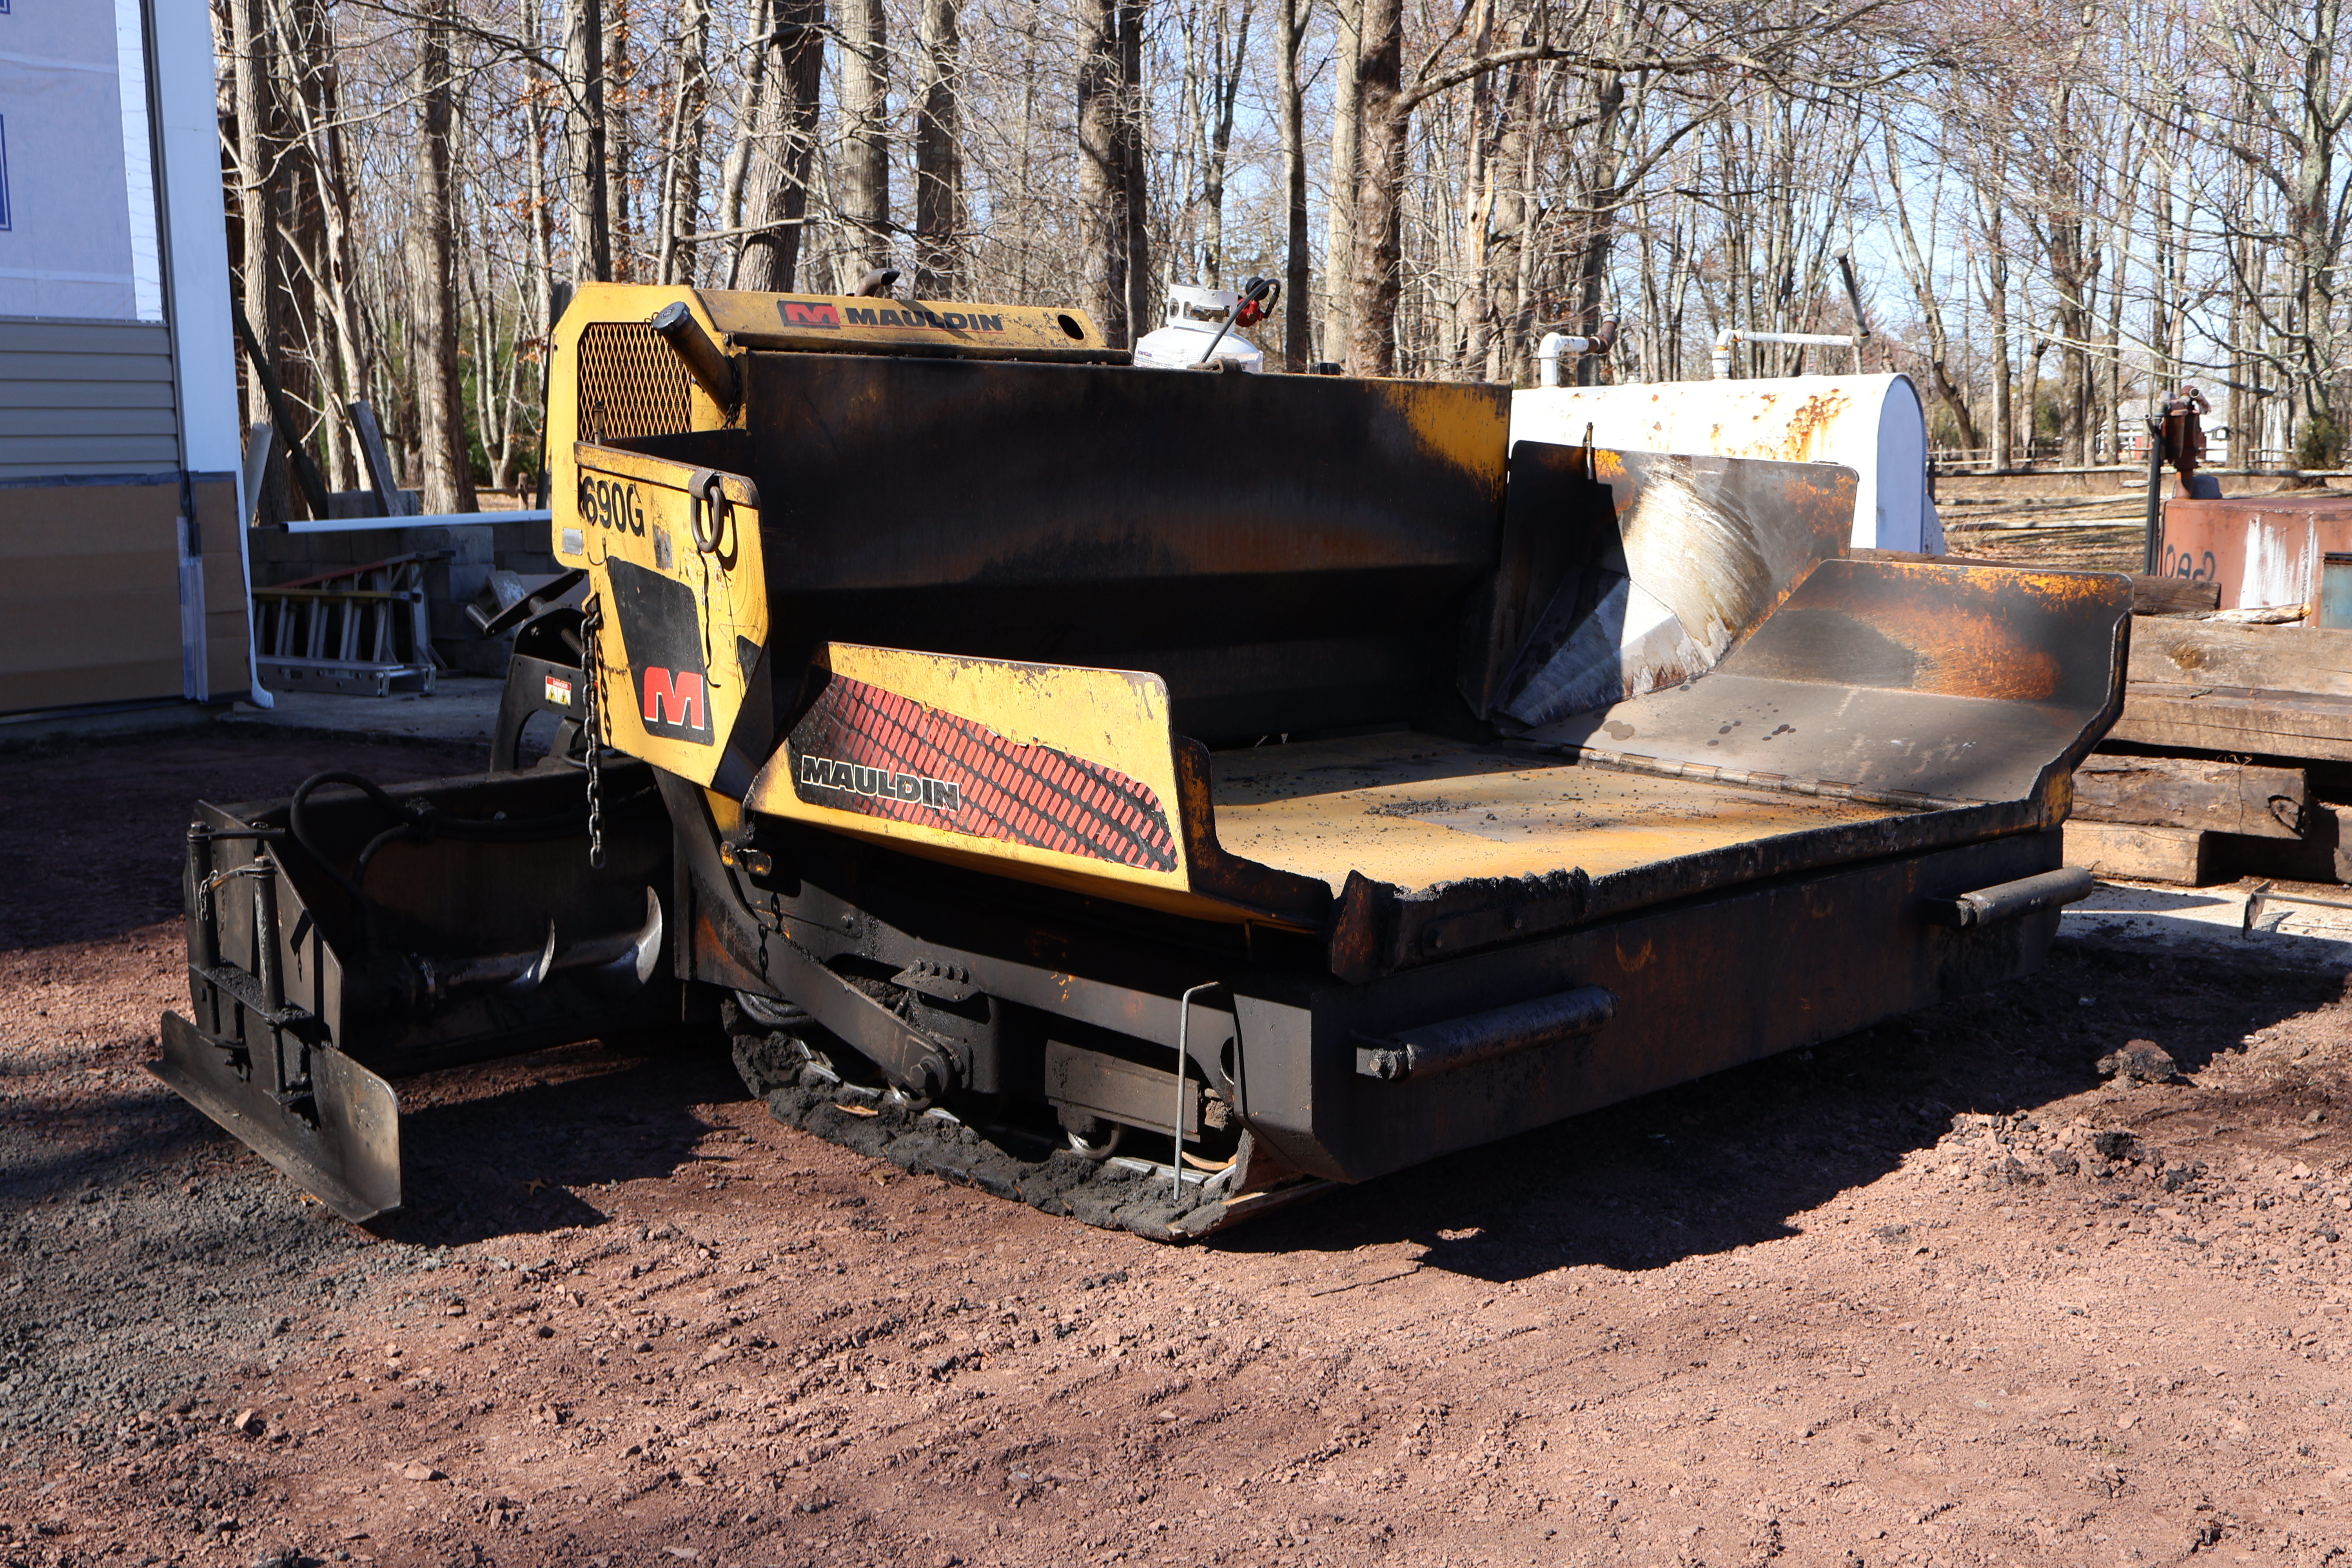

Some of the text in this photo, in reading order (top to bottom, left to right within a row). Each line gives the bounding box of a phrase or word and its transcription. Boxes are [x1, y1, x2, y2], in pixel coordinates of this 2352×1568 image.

[785, 304, 1004, 331] M MAULDIN
[583, 475, 645, 537] 690G
[552, 679, 568, 689] DANGER
[644, 666, 705, 731] M
[801, 755, 960, 812] MAULDIN
